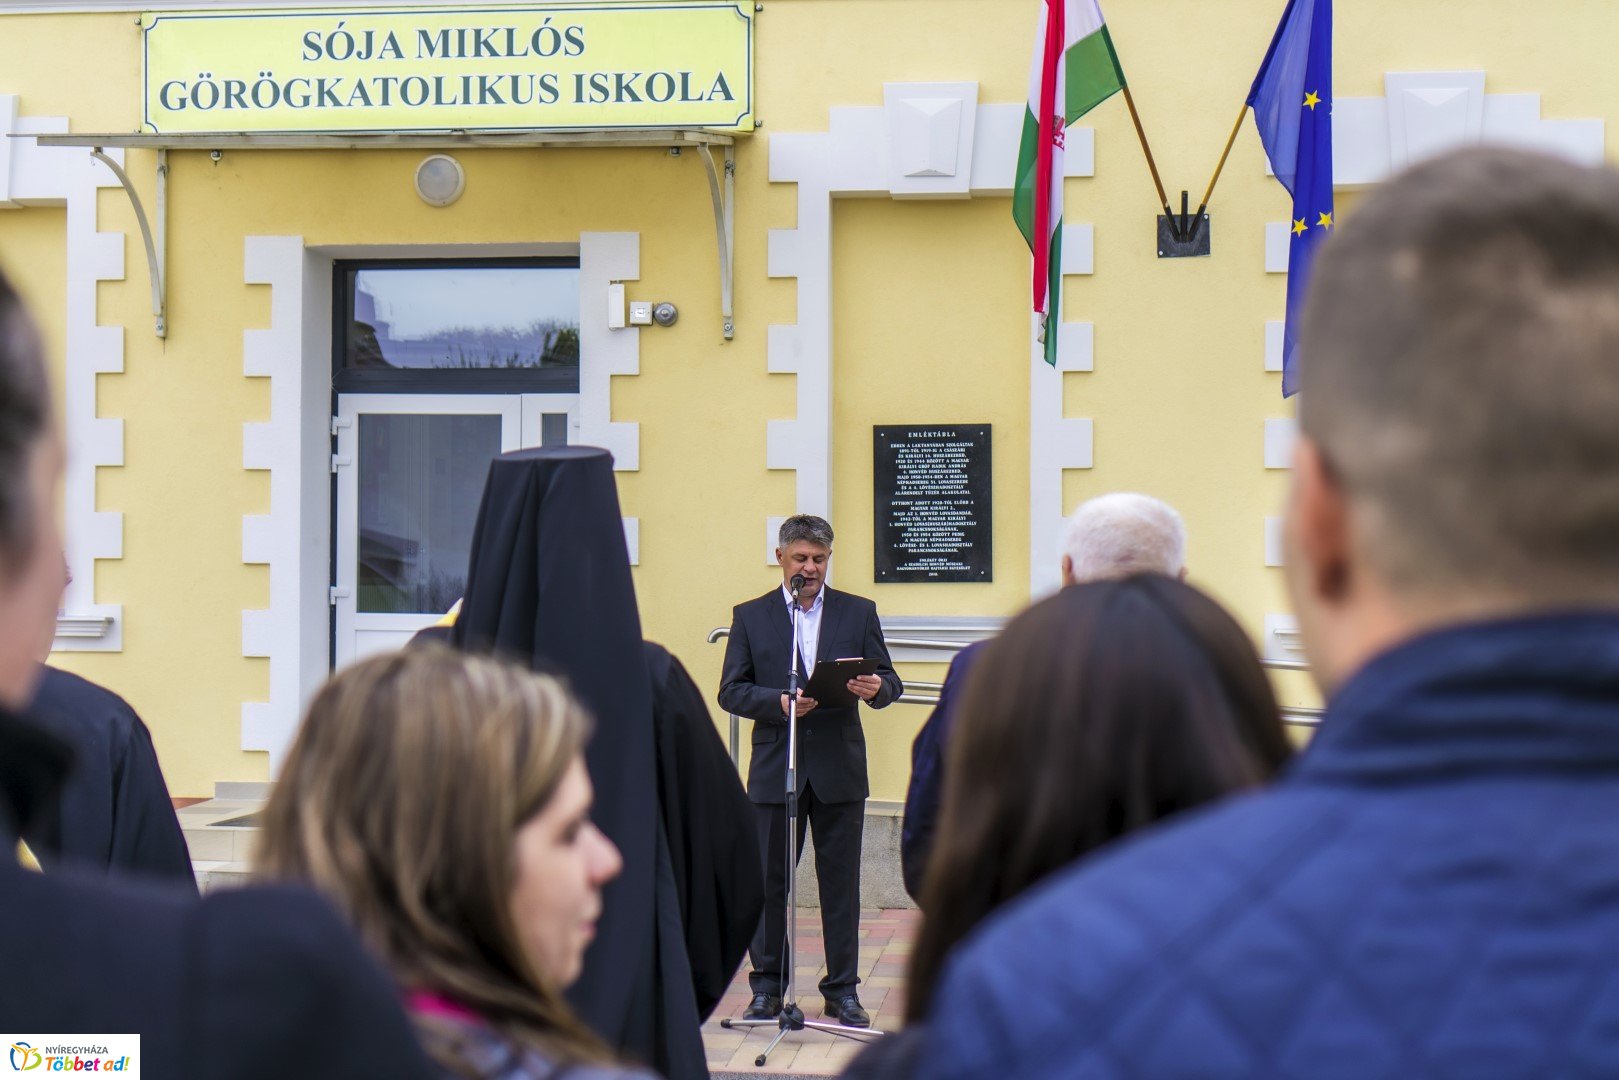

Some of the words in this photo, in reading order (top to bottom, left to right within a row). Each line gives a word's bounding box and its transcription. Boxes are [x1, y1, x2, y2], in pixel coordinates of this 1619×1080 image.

[302, 21, 405, 61] SÓJA
[415, 17, 586, 59] MIKLÓS
[159, 71, 560, 111] GÖRÖGKATOLIKUS
[571, 71, 736, 104] ISKOLA
